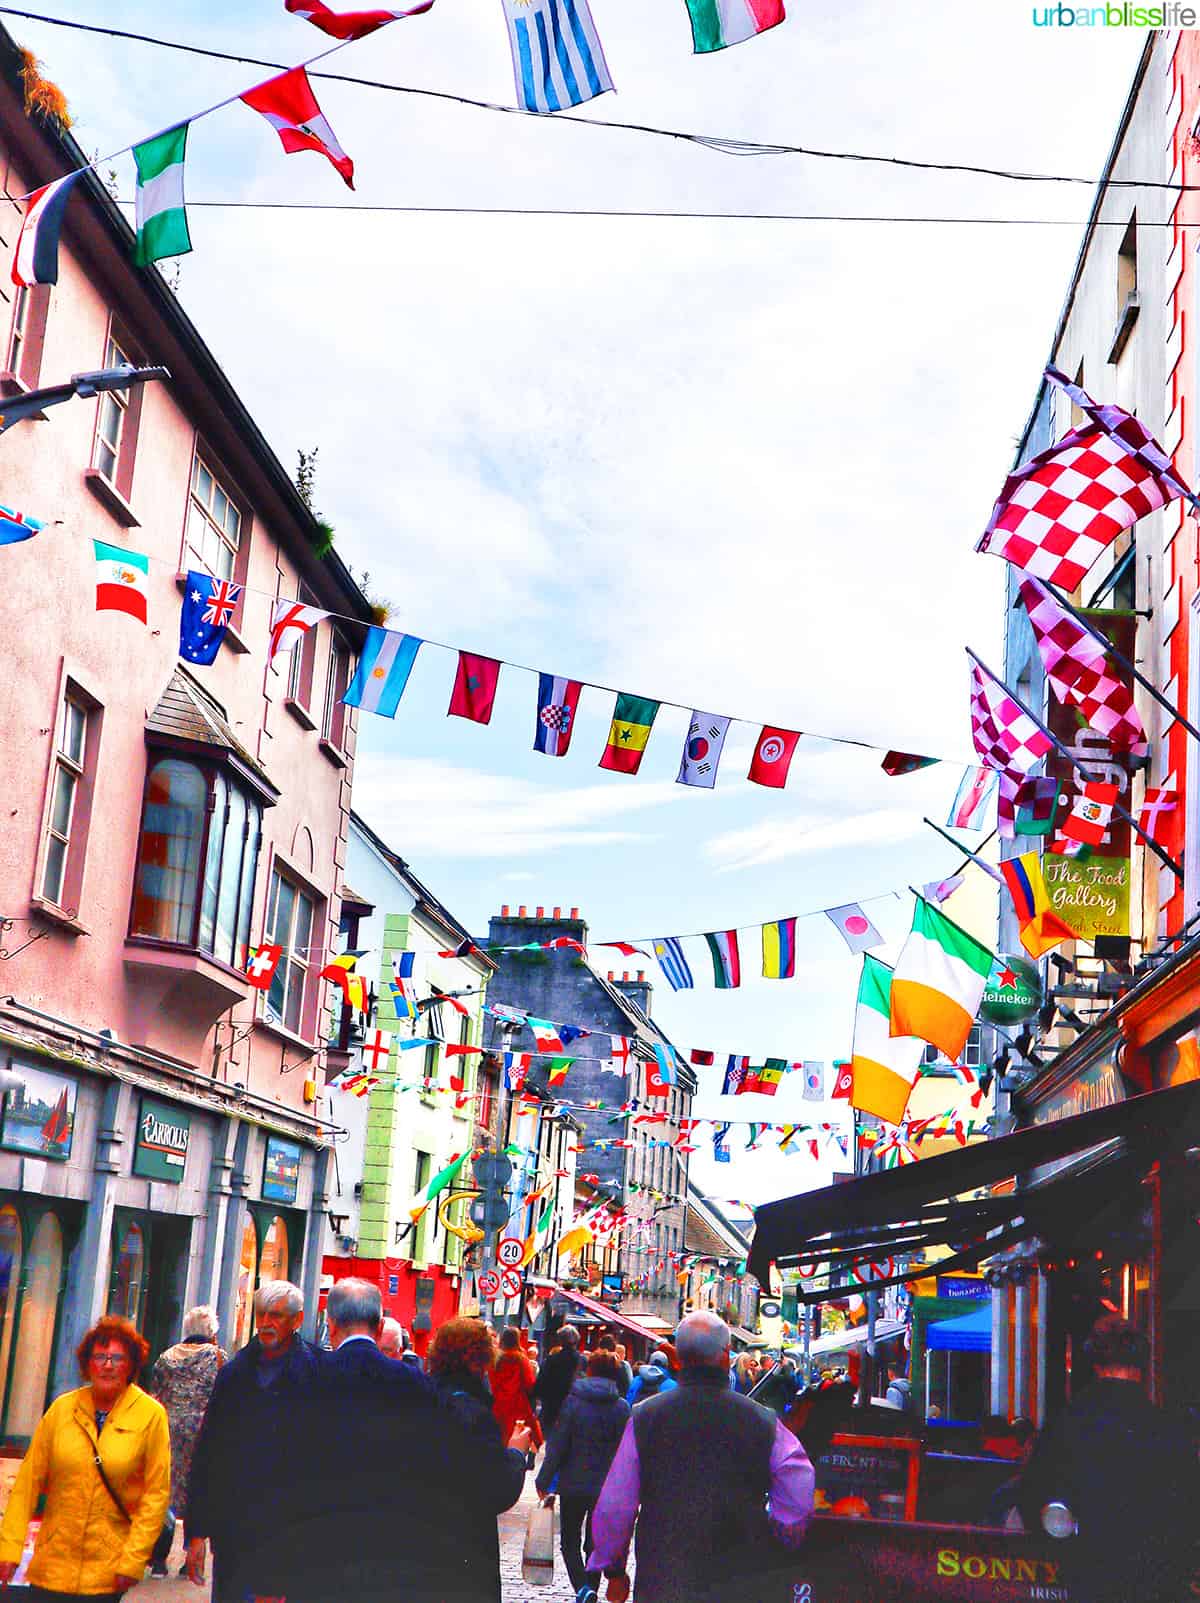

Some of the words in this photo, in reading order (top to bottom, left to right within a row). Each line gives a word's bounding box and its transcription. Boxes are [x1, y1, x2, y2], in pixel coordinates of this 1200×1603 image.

[1047, 861, 1081, 883] The
[1087, 866, 1127, 886] Food
[1053, 884, 1117, 917] Gallery
[504, 1245, 518, 1258] 20
